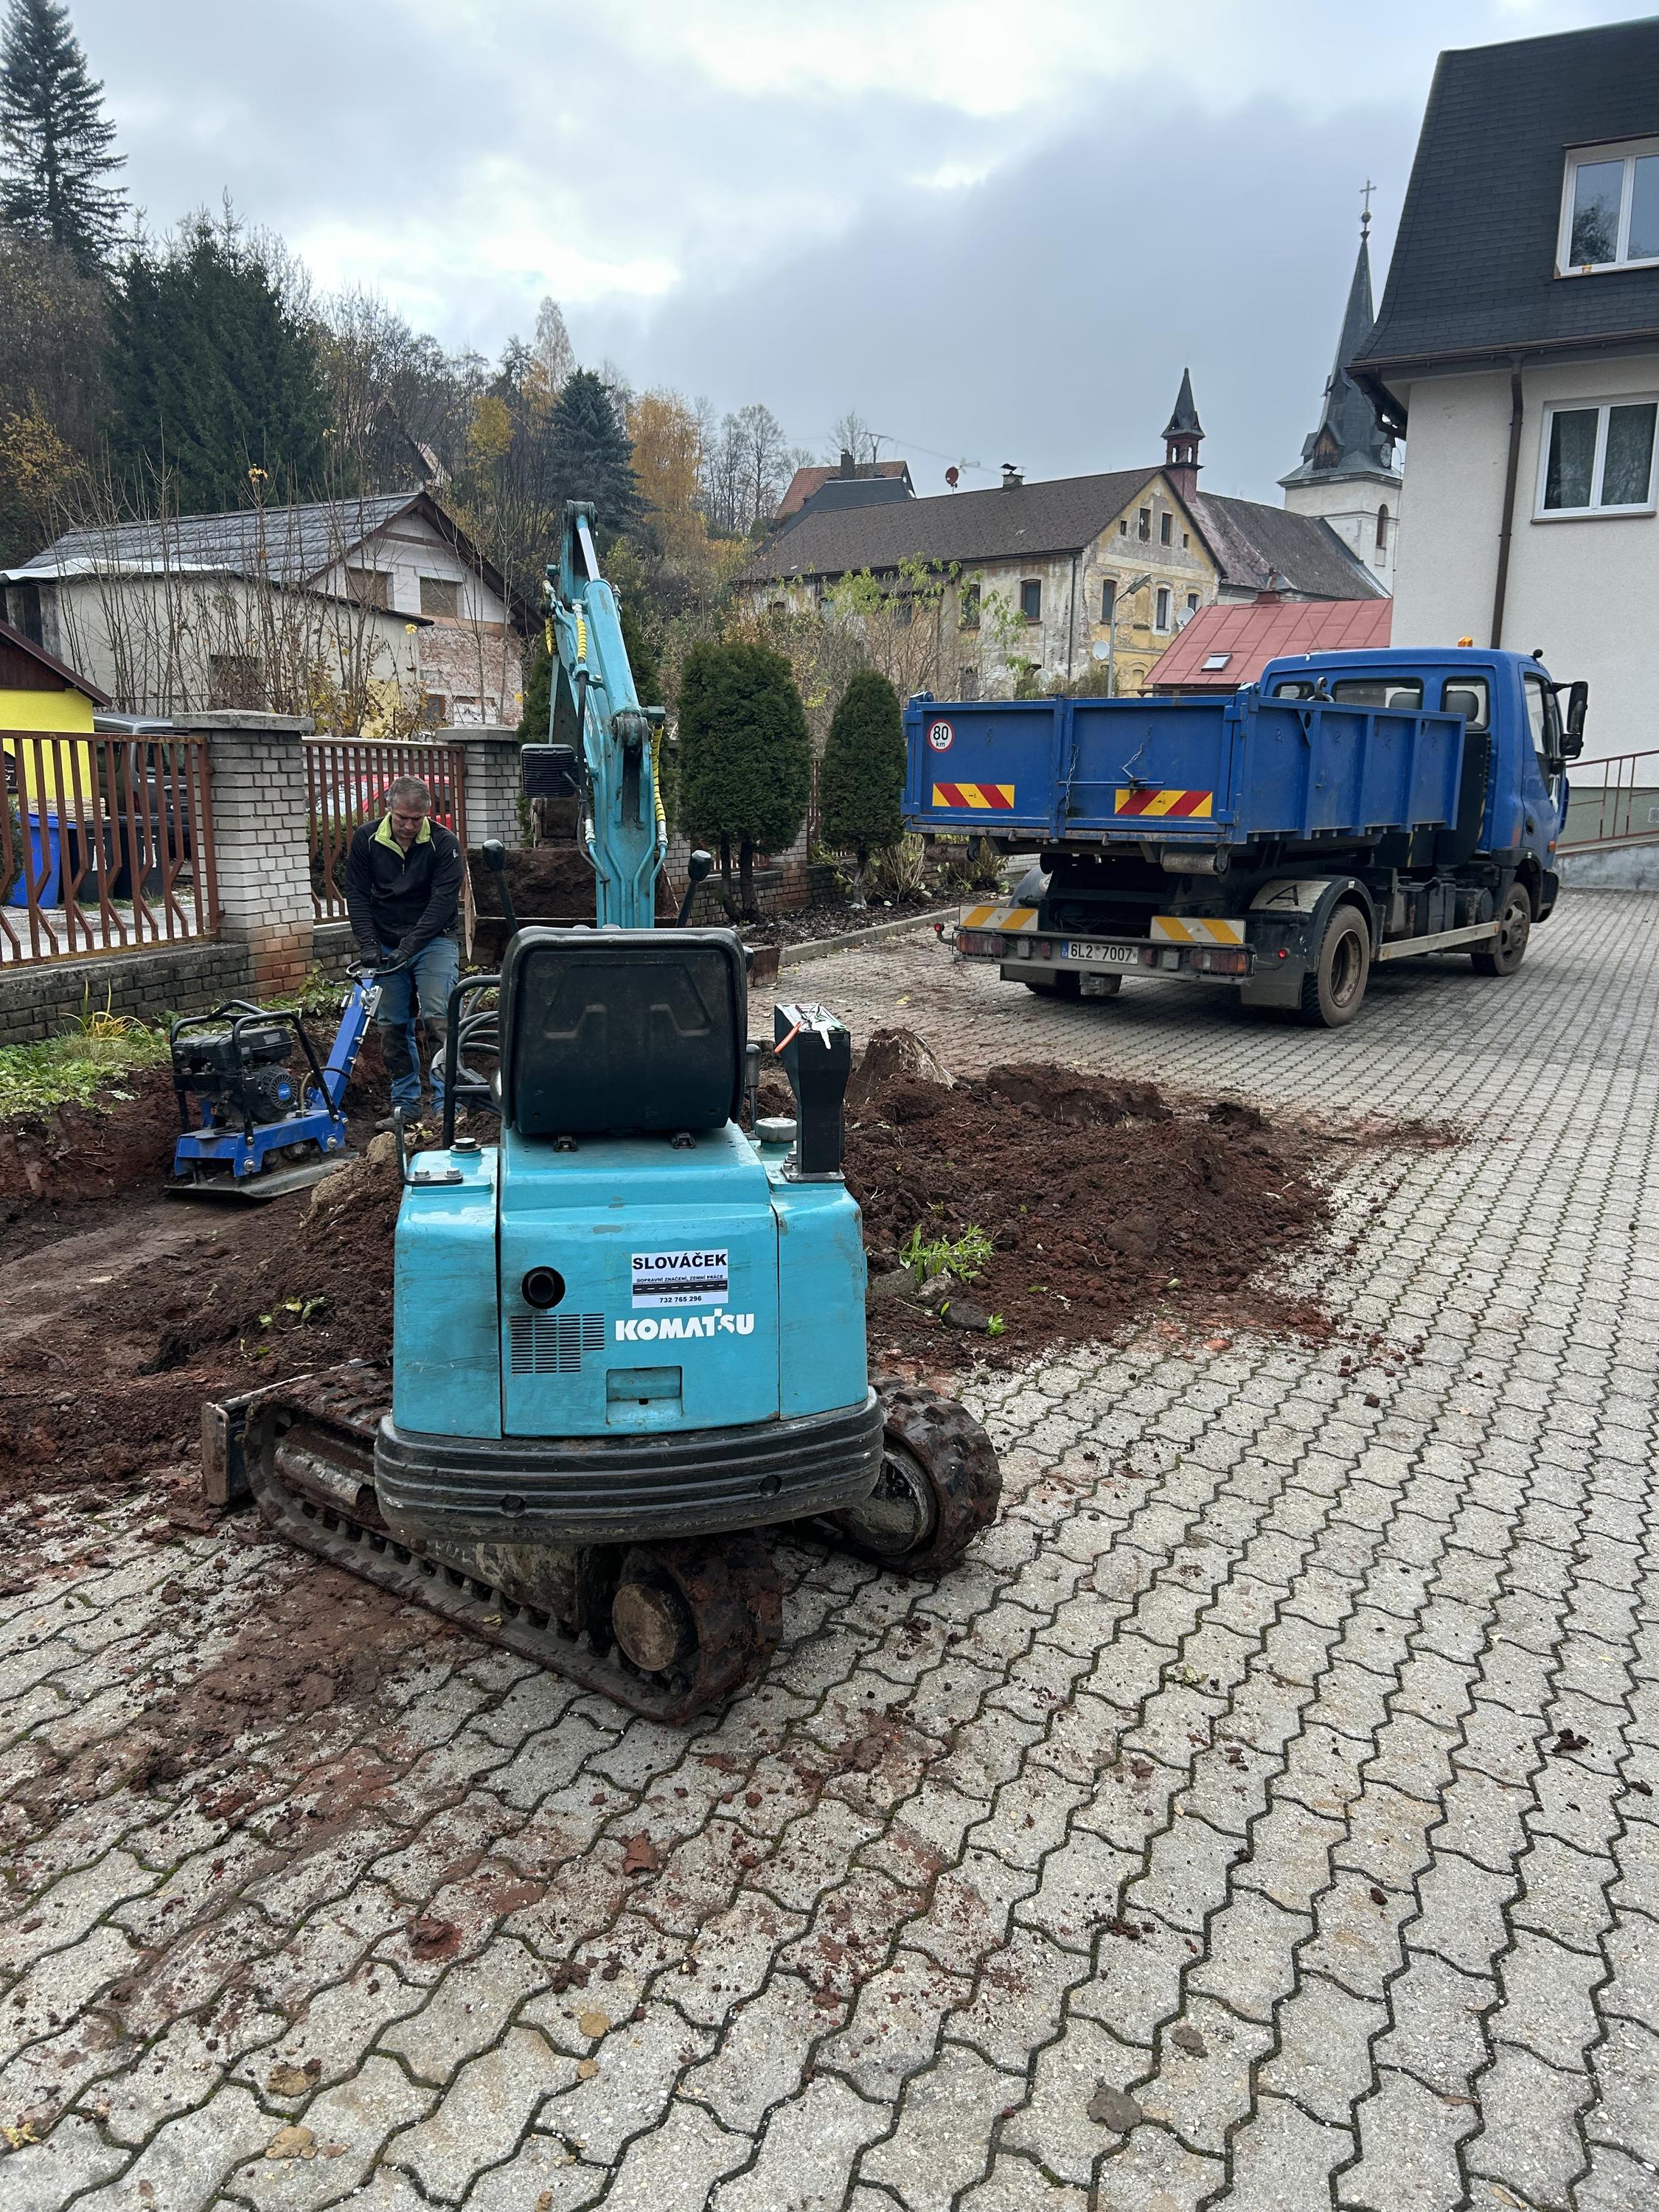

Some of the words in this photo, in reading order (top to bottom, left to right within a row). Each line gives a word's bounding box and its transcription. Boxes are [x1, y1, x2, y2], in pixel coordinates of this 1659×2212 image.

[933, 726, 949, 740] 80
[1265, 884, 1299, 906] A
[1071, 944, 1093, 959] 6L2
[1102, 946, 1133, 961] 7007
[633, 1252, 727, 1270] SLOVÁČEK
[615, 1308, 755, 1341] KOMATSU
